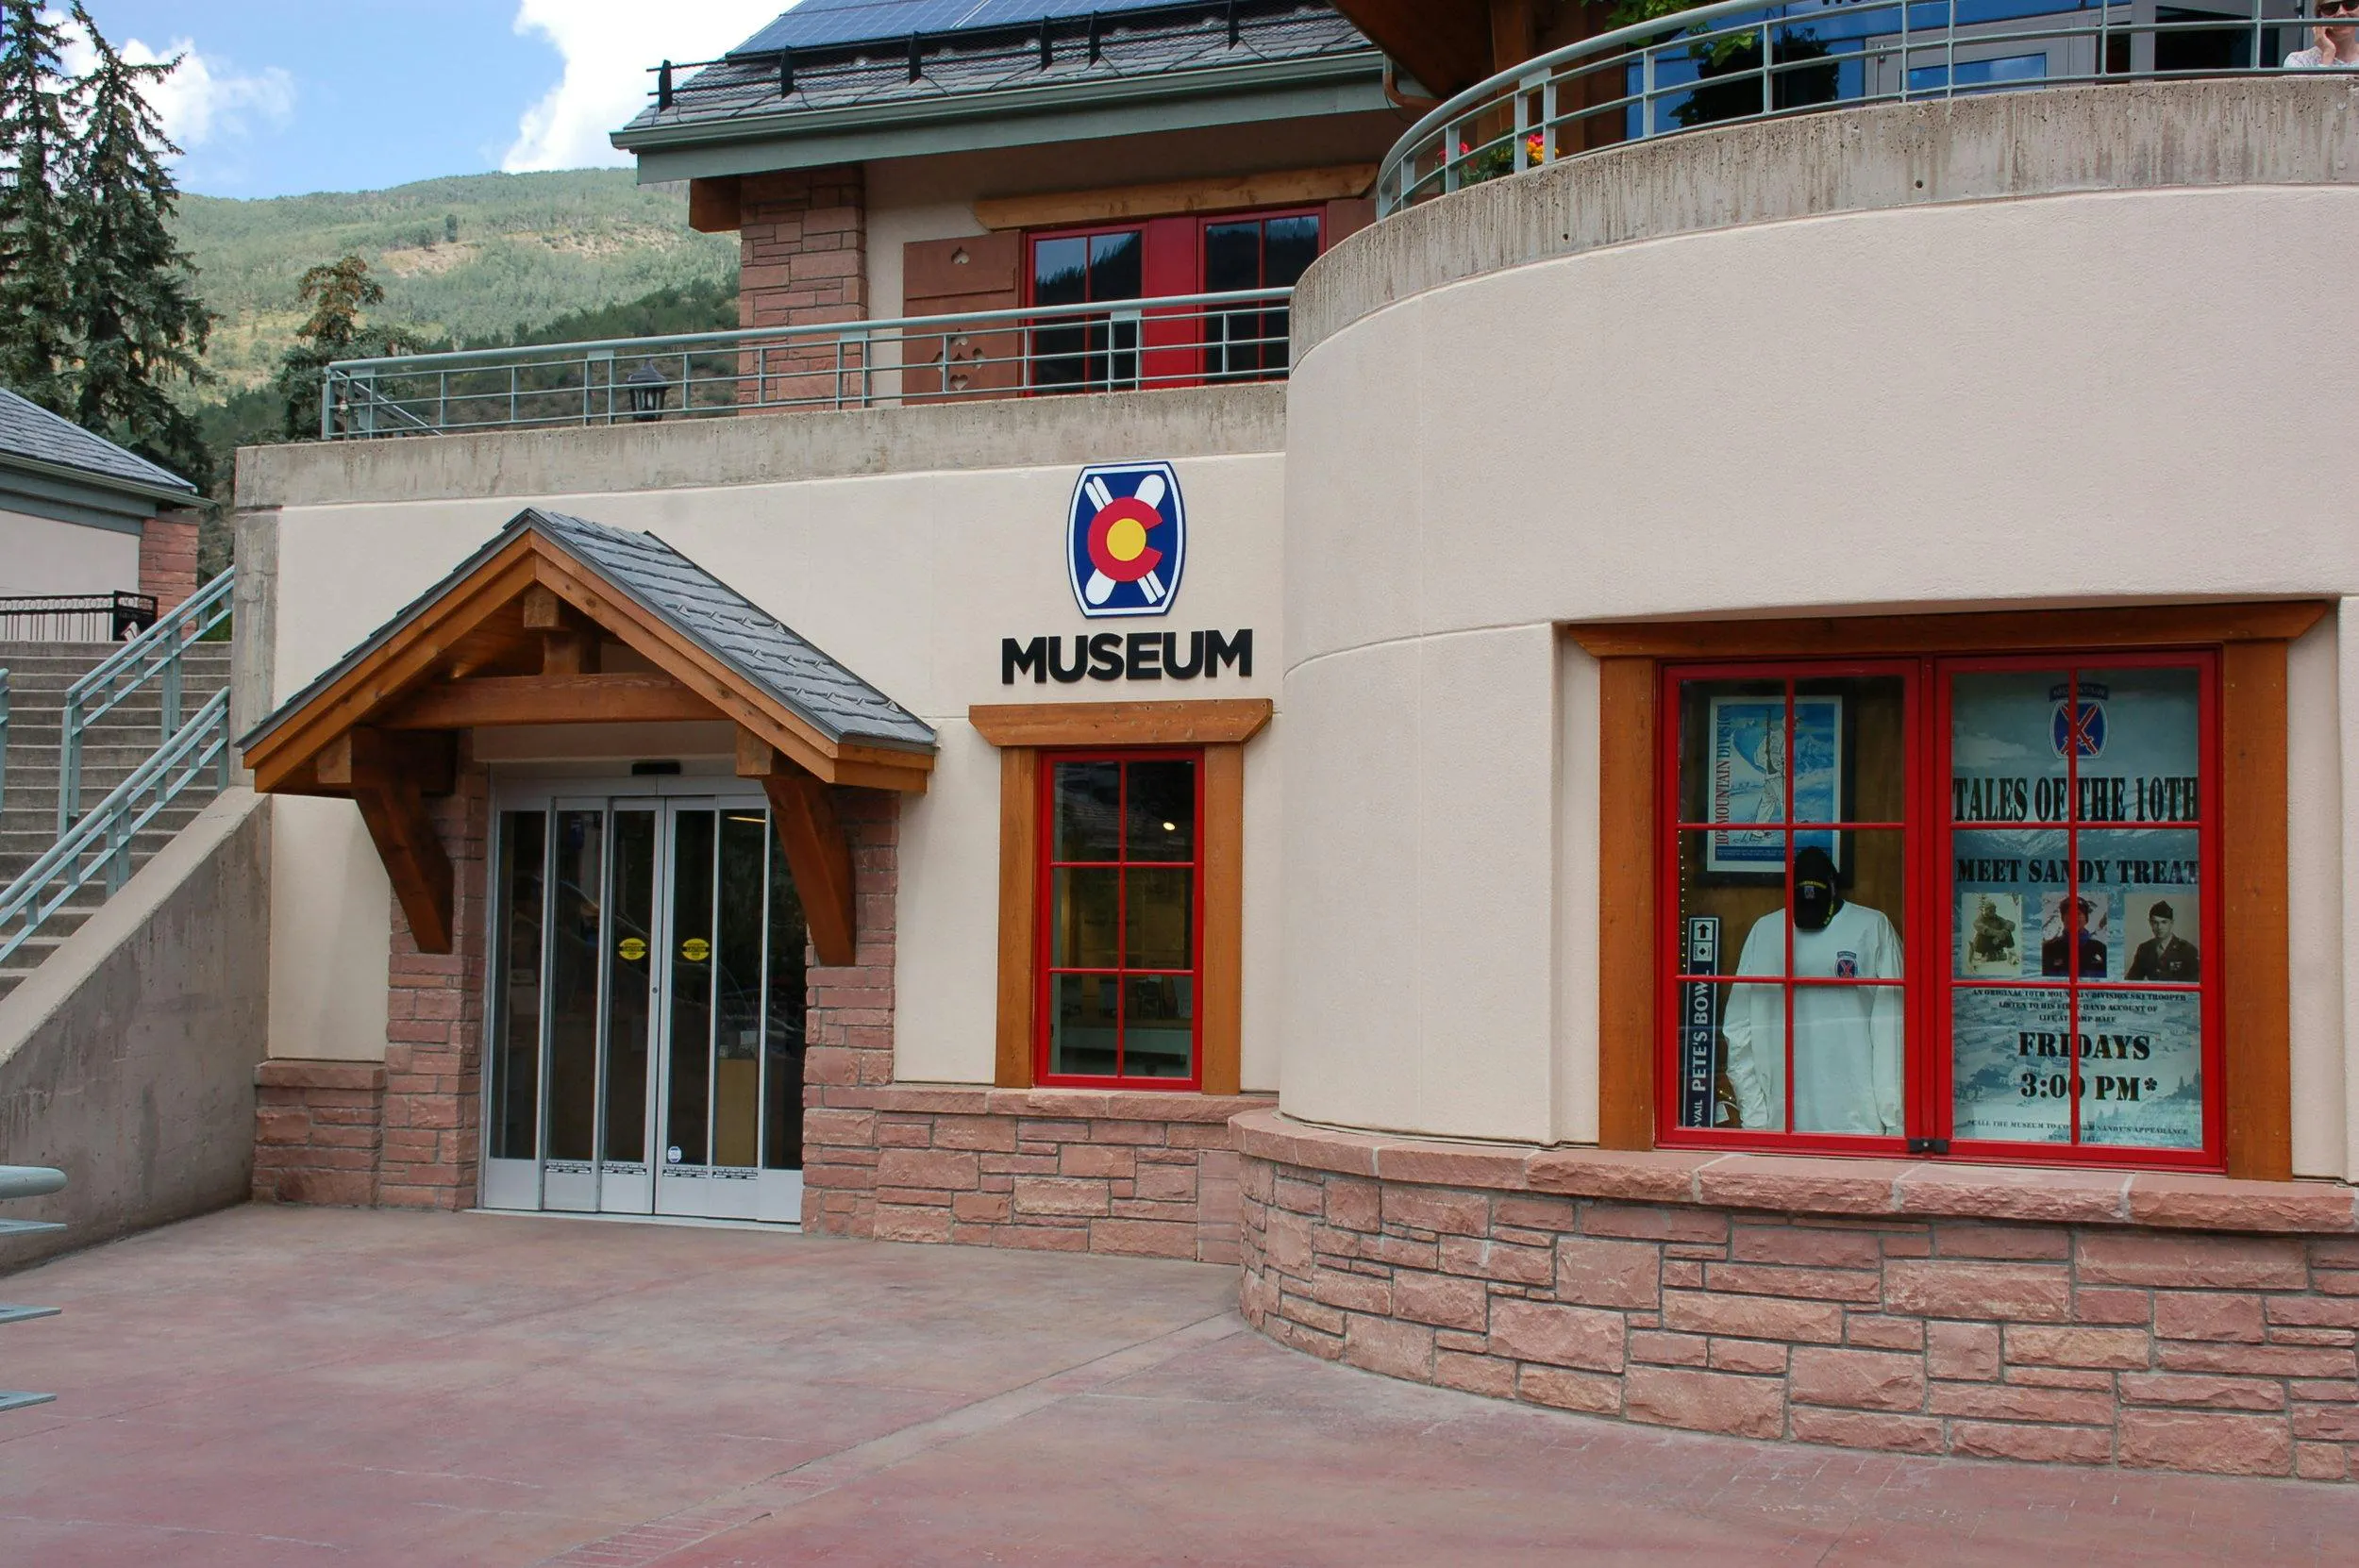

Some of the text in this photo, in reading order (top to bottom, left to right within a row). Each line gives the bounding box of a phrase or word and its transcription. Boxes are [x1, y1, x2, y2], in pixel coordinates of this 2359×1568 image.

[1002, 628, 1253, 685] MUSEUM
[1715, 760, 1730, 824] MOUNTAIN
[1953, 776, 2199, 823] TALES OF THE 10TH
[1956, 859, 2022, 883] MEET
[2116, 859, 2199, 885] TREAT
[2048, 991, 2089, 999] MOUNAIN
[2147, 993, 2186, 1002] TROOPER
[2108, 1004, 2145, 1012] ACCOUNT
[2018, 1031, 2150, 1060] FRIDAYS
[1691, 1031, 1709, 1093] PETE'S
[1693, 1098, 1704, 1123] VAIL
[2010, 1121, 2044, 1129] MUSEUM
[2133, 1126, 2189, 1135] APPEARANCE
